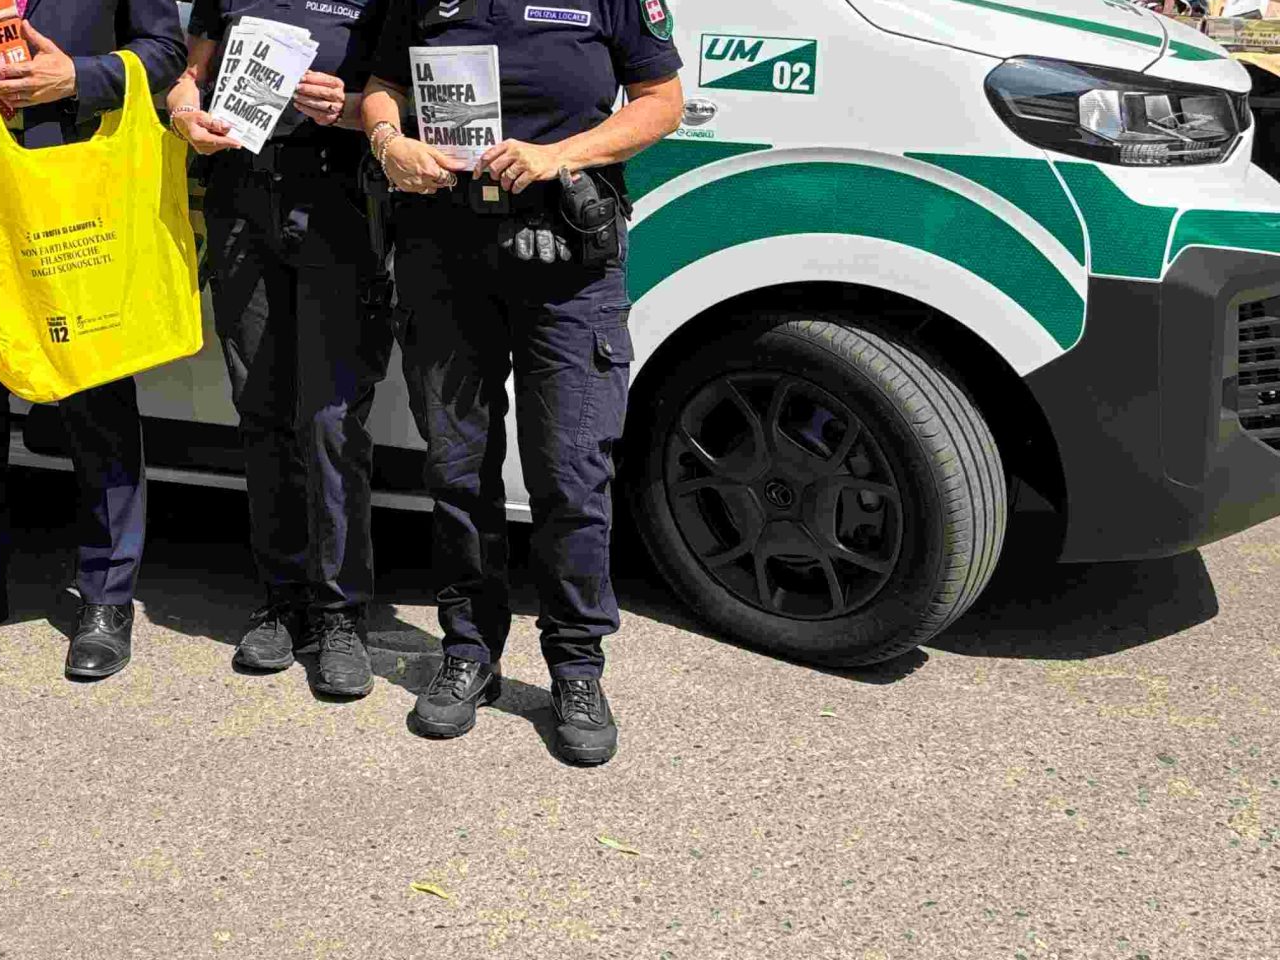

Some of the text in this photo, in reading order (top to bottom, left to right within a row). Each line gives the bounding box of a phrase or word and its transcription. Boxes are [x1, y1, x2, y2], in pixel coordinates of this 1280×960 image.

[305, 0, 361, 20] POLIZIA LOCALE
[529, 9, 587, 22] POLIZIA LOCALE
[228, 39, 244, 56] LA
[252, 40, 270, 61] LA
[704, 38, 764, 62] UM
[243, 58, 285, 92] TRUFFA
[415, 62, 434, 82] LA
[772, 60, 811, 91] 02
[418, 83, 477, 103] TRUFFA
[223, 93, 273, 131] CAMUFFA
[423, 126, 496, 146] CAMUFFA
[21, 230, 118, 257] NON FARTI RACCONTARE
[40, 245, 101, 267] FILASTROCCHE
[31, 266, 57, 278] DAGLI
[48, 326, 70, 343] 112
